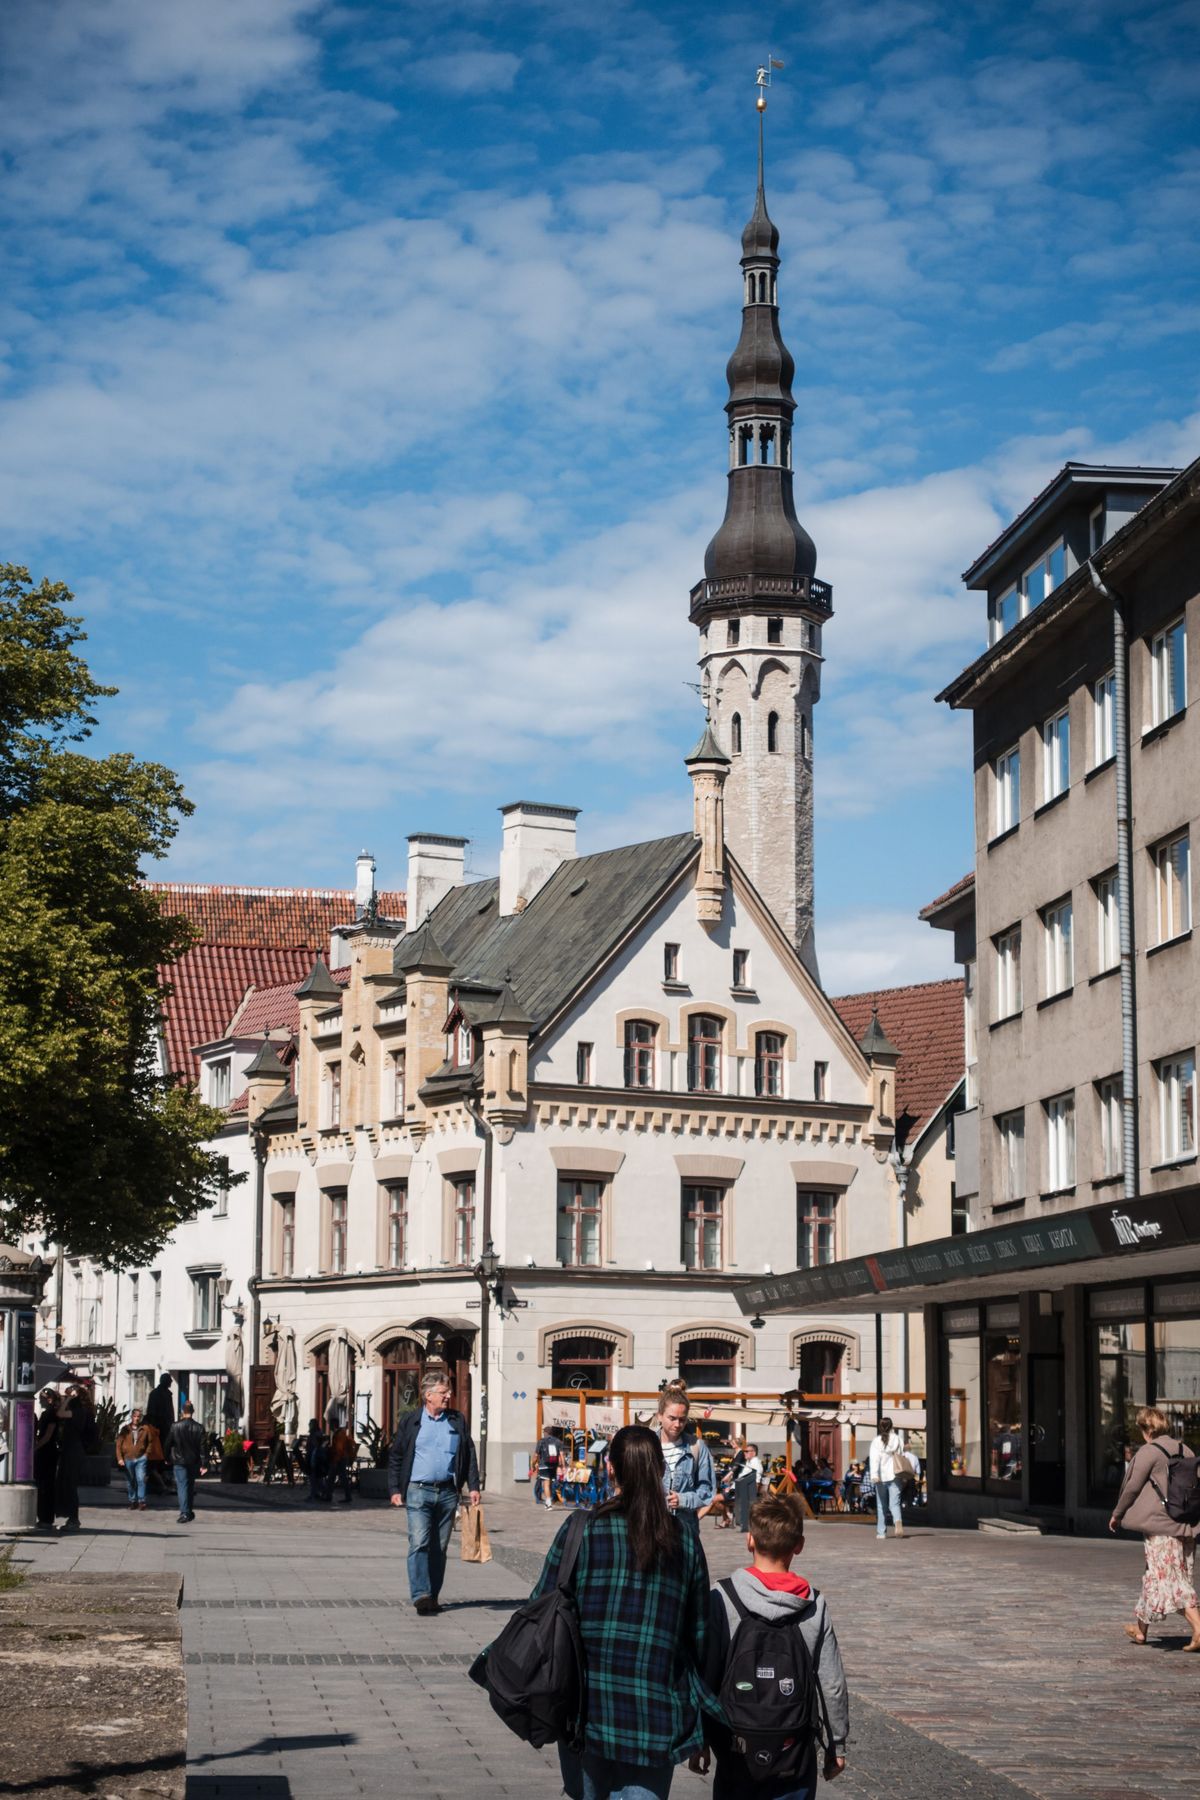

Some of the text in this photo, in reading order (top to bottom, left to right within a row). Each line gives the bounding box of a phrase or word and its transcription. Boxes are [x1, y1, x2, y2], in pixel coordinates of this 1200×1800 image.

[1048, 1227, 1078, 1249] КНИГИ
[553, 1418, 576, 1427] TANKER
[595, 1424, 619, 1433] TANKER
